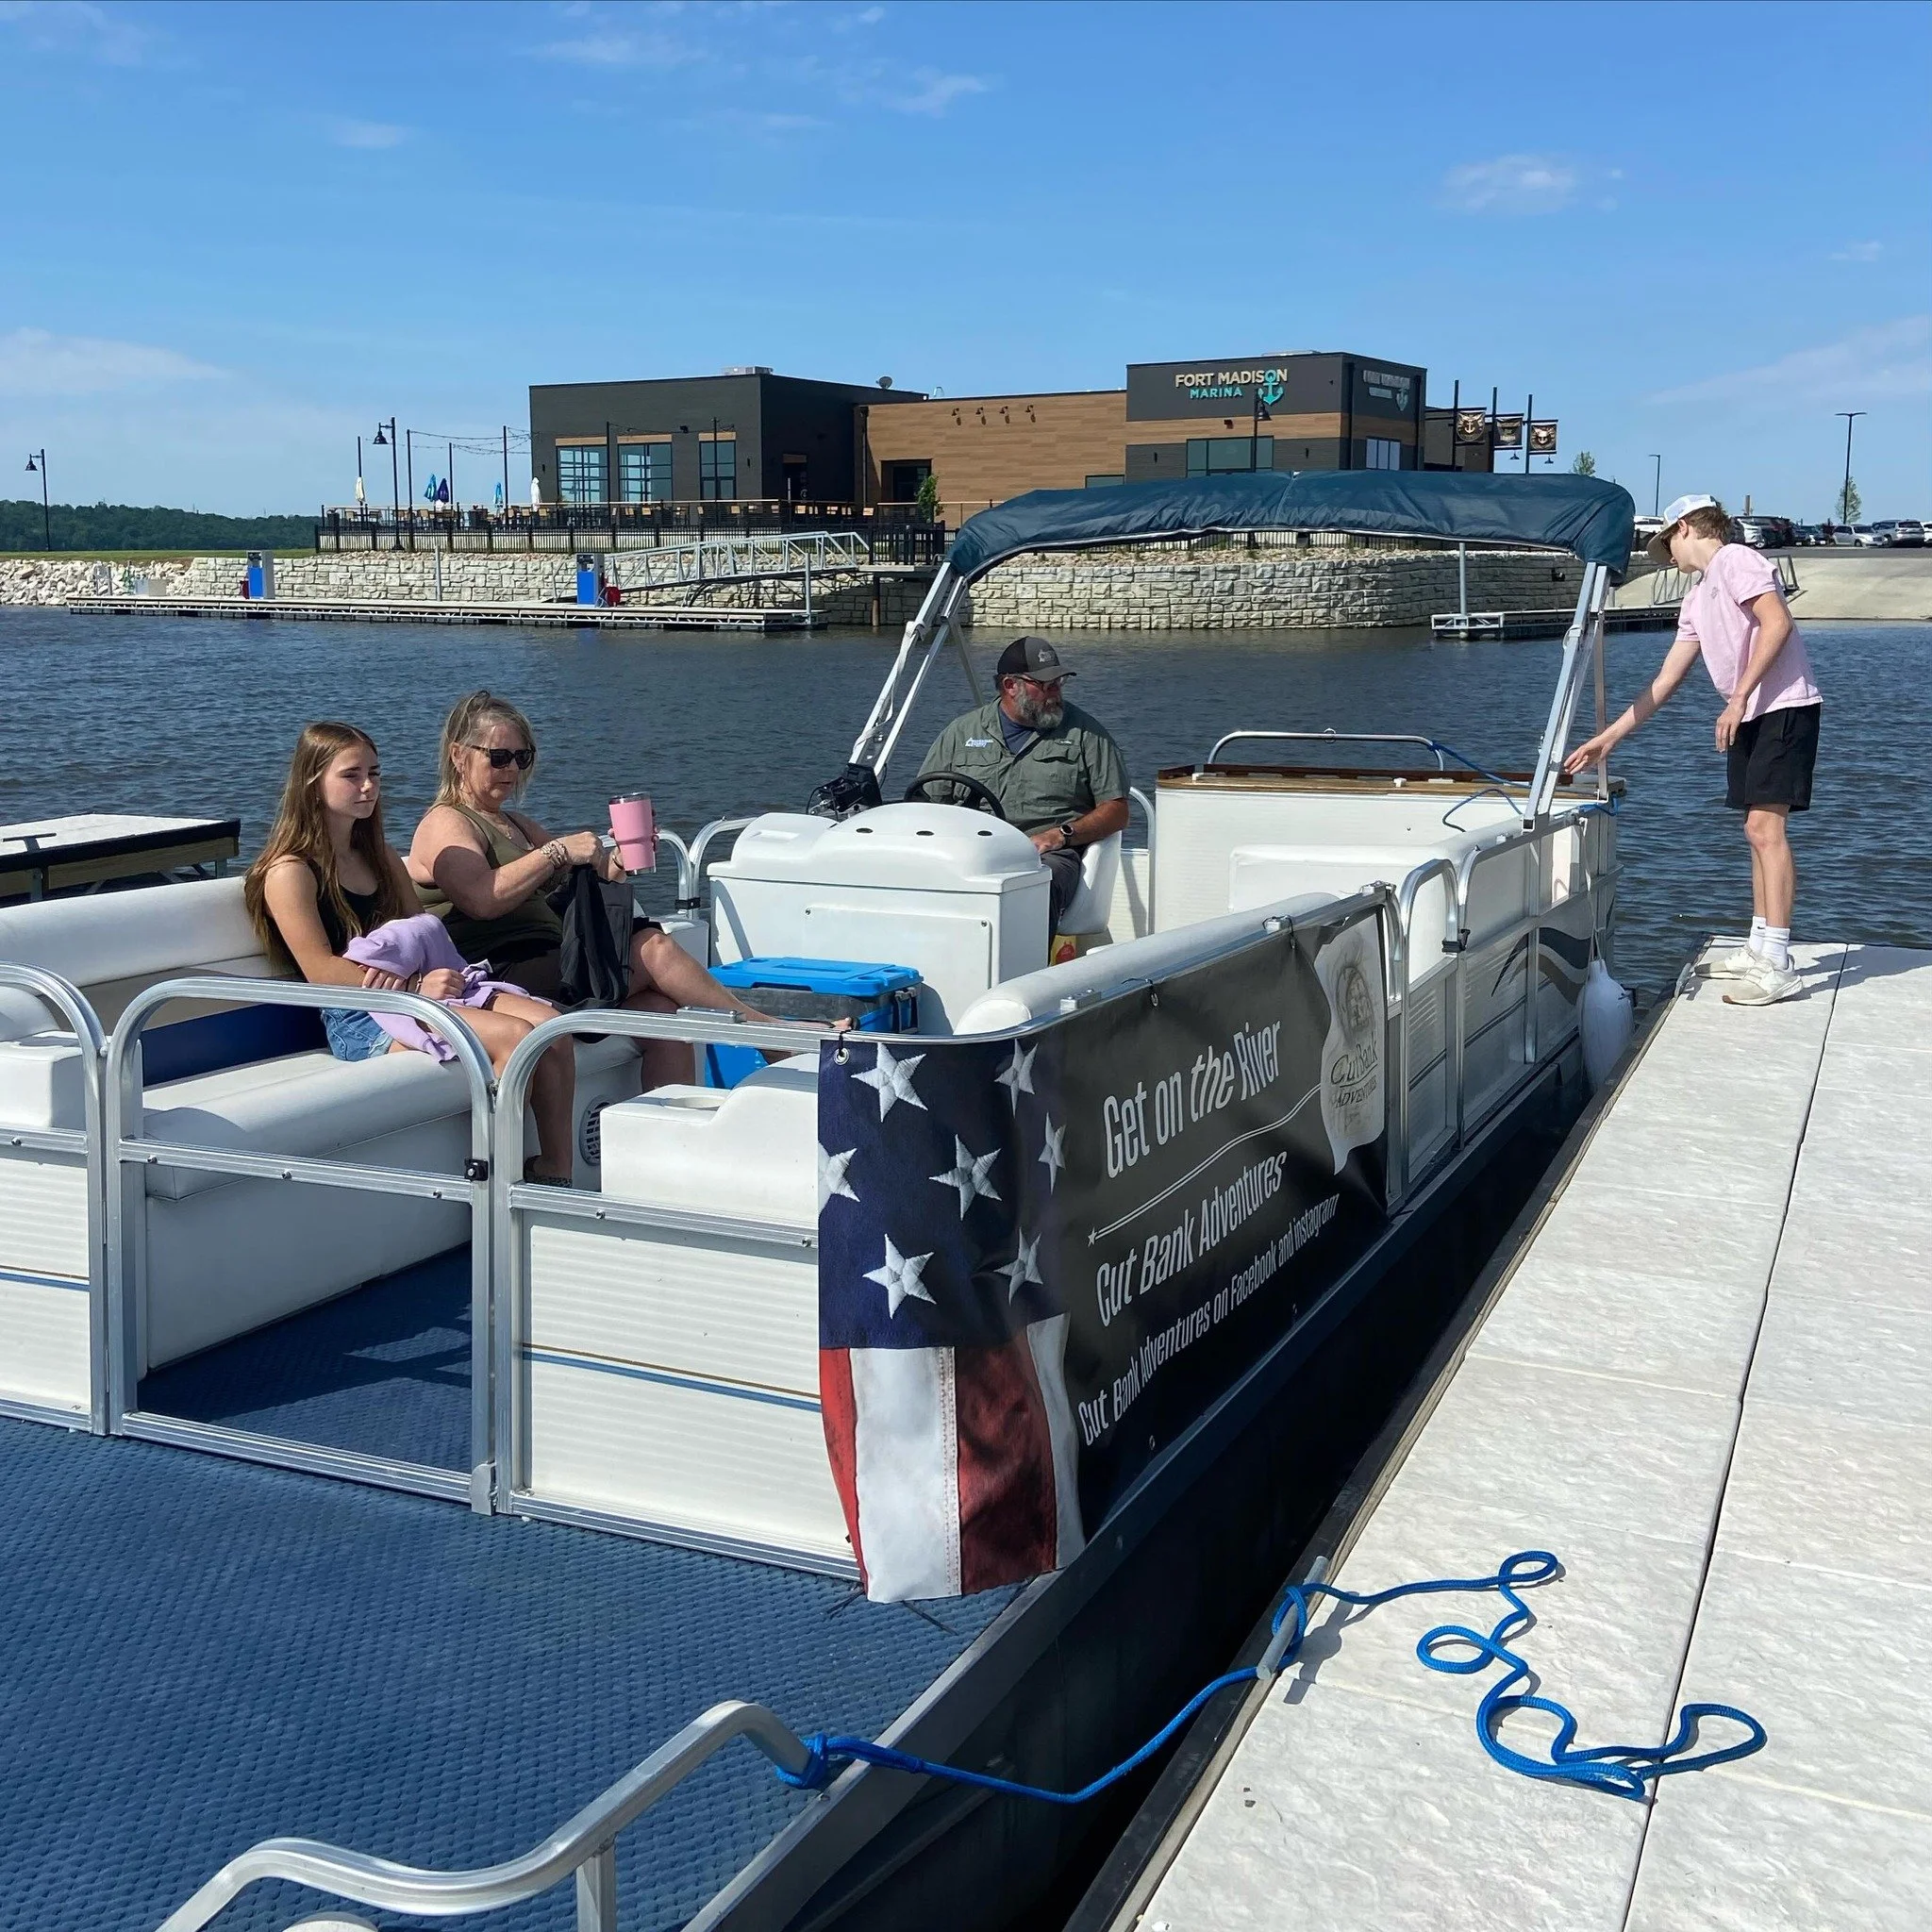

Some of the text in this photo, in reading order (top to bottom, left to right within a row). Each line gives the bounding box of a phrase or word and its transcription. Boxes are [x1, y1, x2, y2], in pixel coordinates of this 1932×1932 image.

[1175, 369, 1288, 388] FORT MADISON
[1190, 387, 1243, 399] MARINA
[1104, 1020, 1281, 1178] Get on the River
[1096, 1151, 1287, 1327] Cut Bank Adventures
[1078, 1192, 1341, 1446] Cut Bank Adventures on Facebook and instagram
